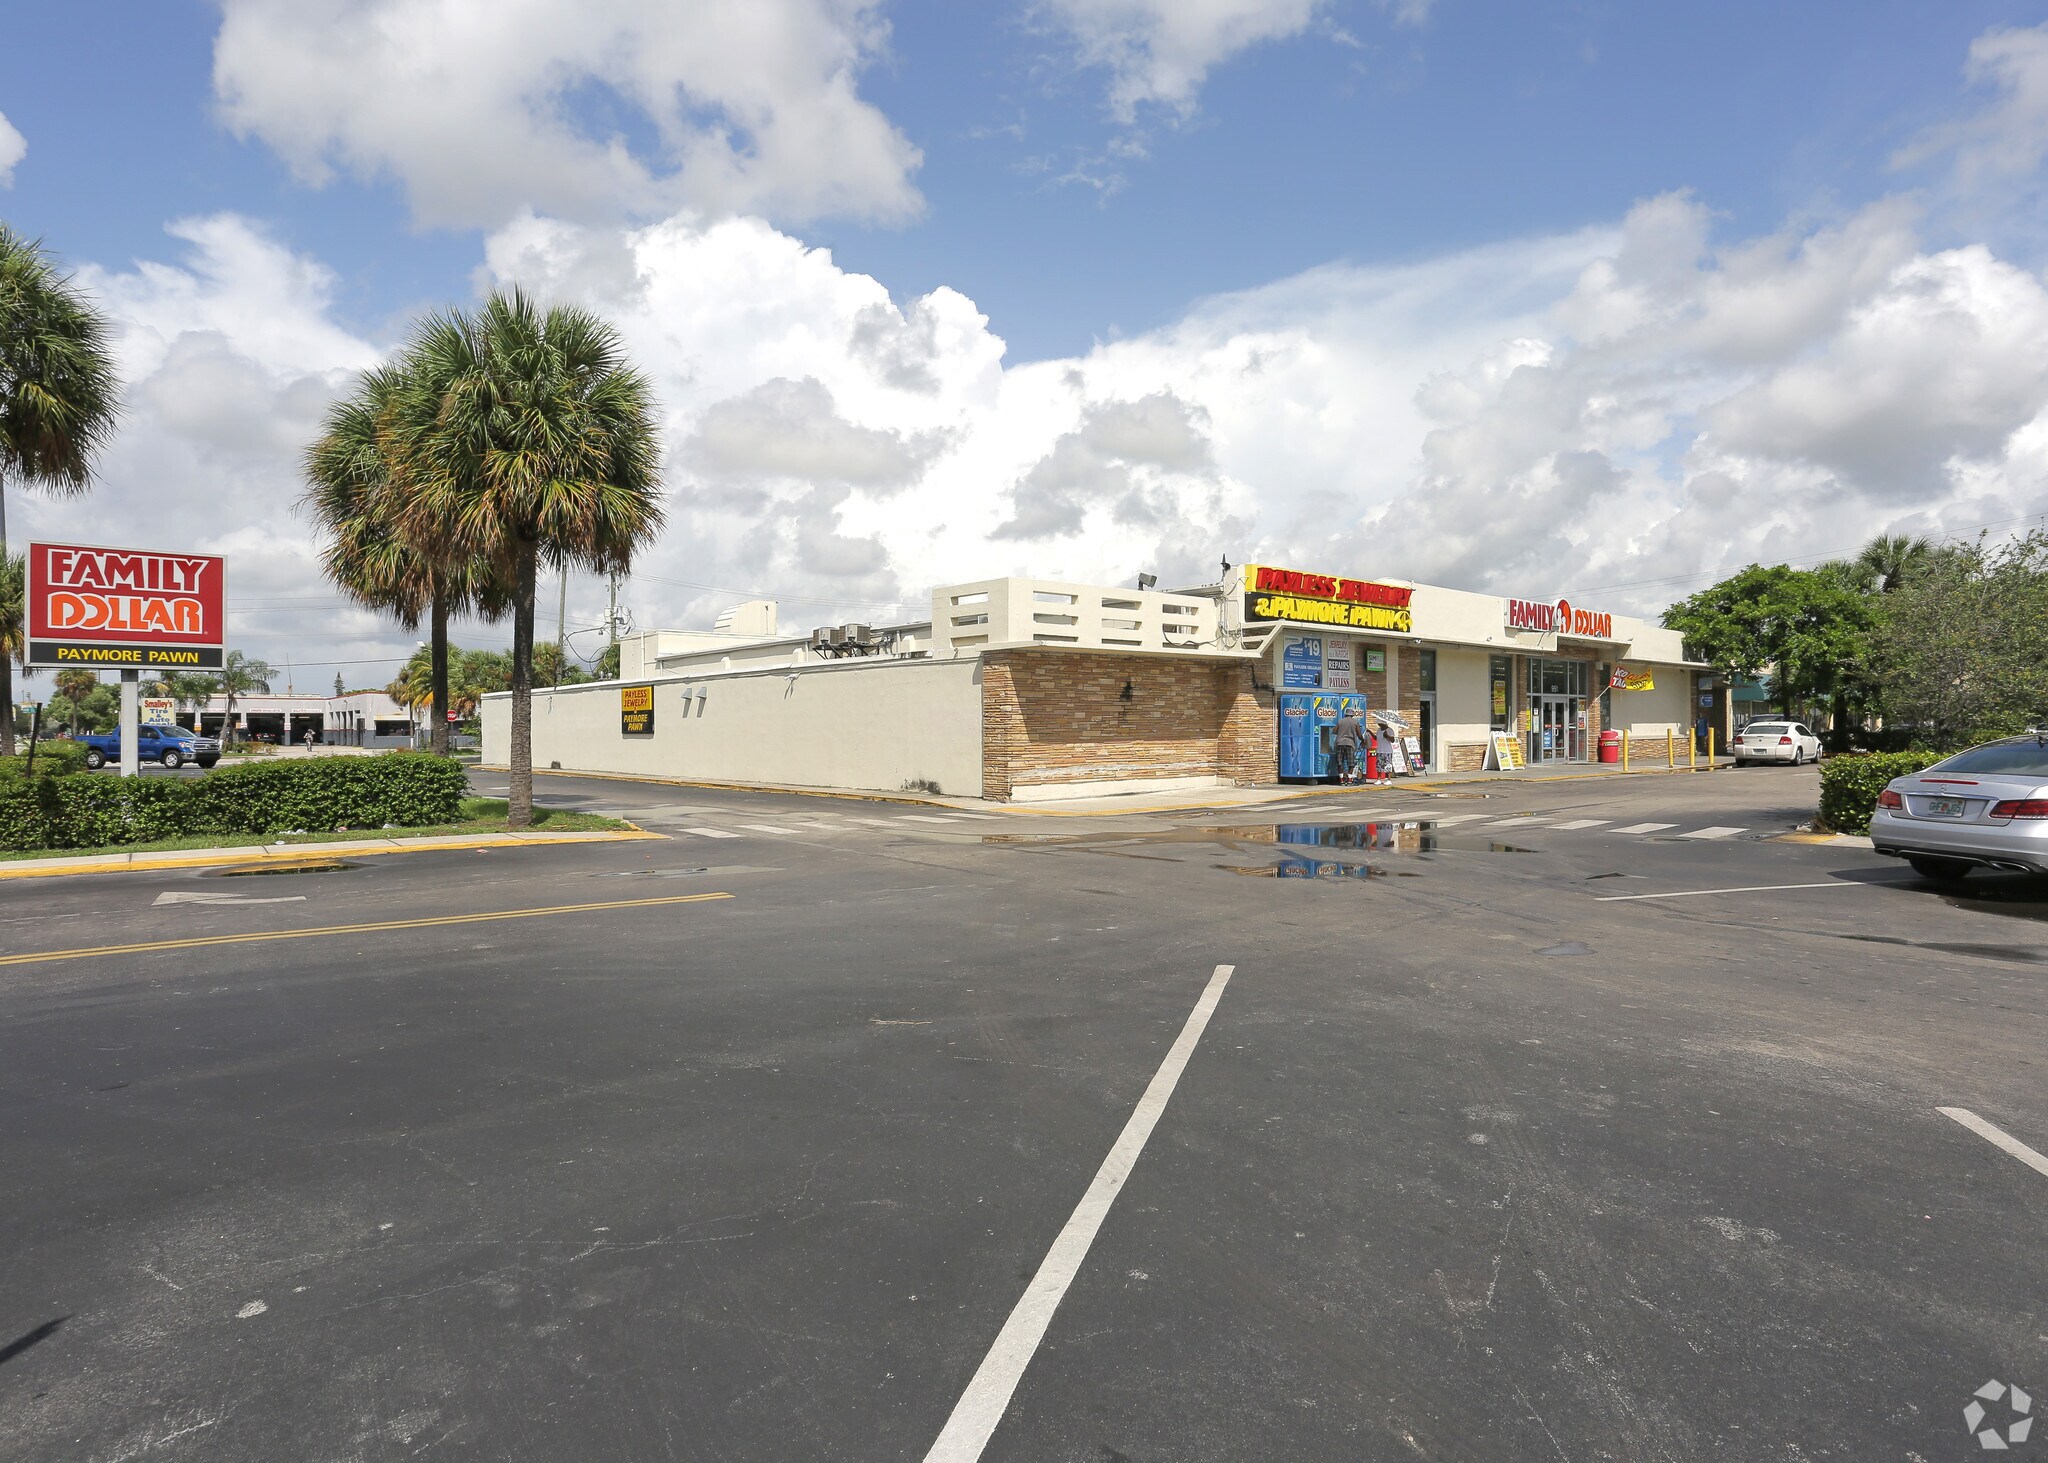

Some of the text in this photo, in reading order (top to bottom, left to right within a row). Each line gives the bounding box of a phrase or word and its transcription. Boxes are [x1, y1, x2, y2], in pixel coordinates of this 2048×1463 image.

[48, 549, 209, 594] FAMILY
[1256, 567, 1412, 606] PAYLESS JEWELRY
[48, 591, 203, 634] DOLLAR
[1255, 596, 1394, 629] & PAYMORE PAWN
[1510, 599, 1611, 638] FAMILY DOLLAR
[1329, 640, 1347, 649] JEWELRY
[58, 648, 199, 663] PAYMORE PAWN
[1329, 661, 1349, 670] REPAIRS
[1329, 677, 1349, 687] PAYLESS
[625, 690, 646, 698] PAYLESS
[144, 700, 172, 709] Smalley's
[624, 699, 647, 707] JEWELRY
[1284, 708, 1308, 716] Glacier
[1317, 708, 1337, 717] Glacier
[624, 714, 648, 722] PAYMORE
[628, 723, 643, 731] PAWN
